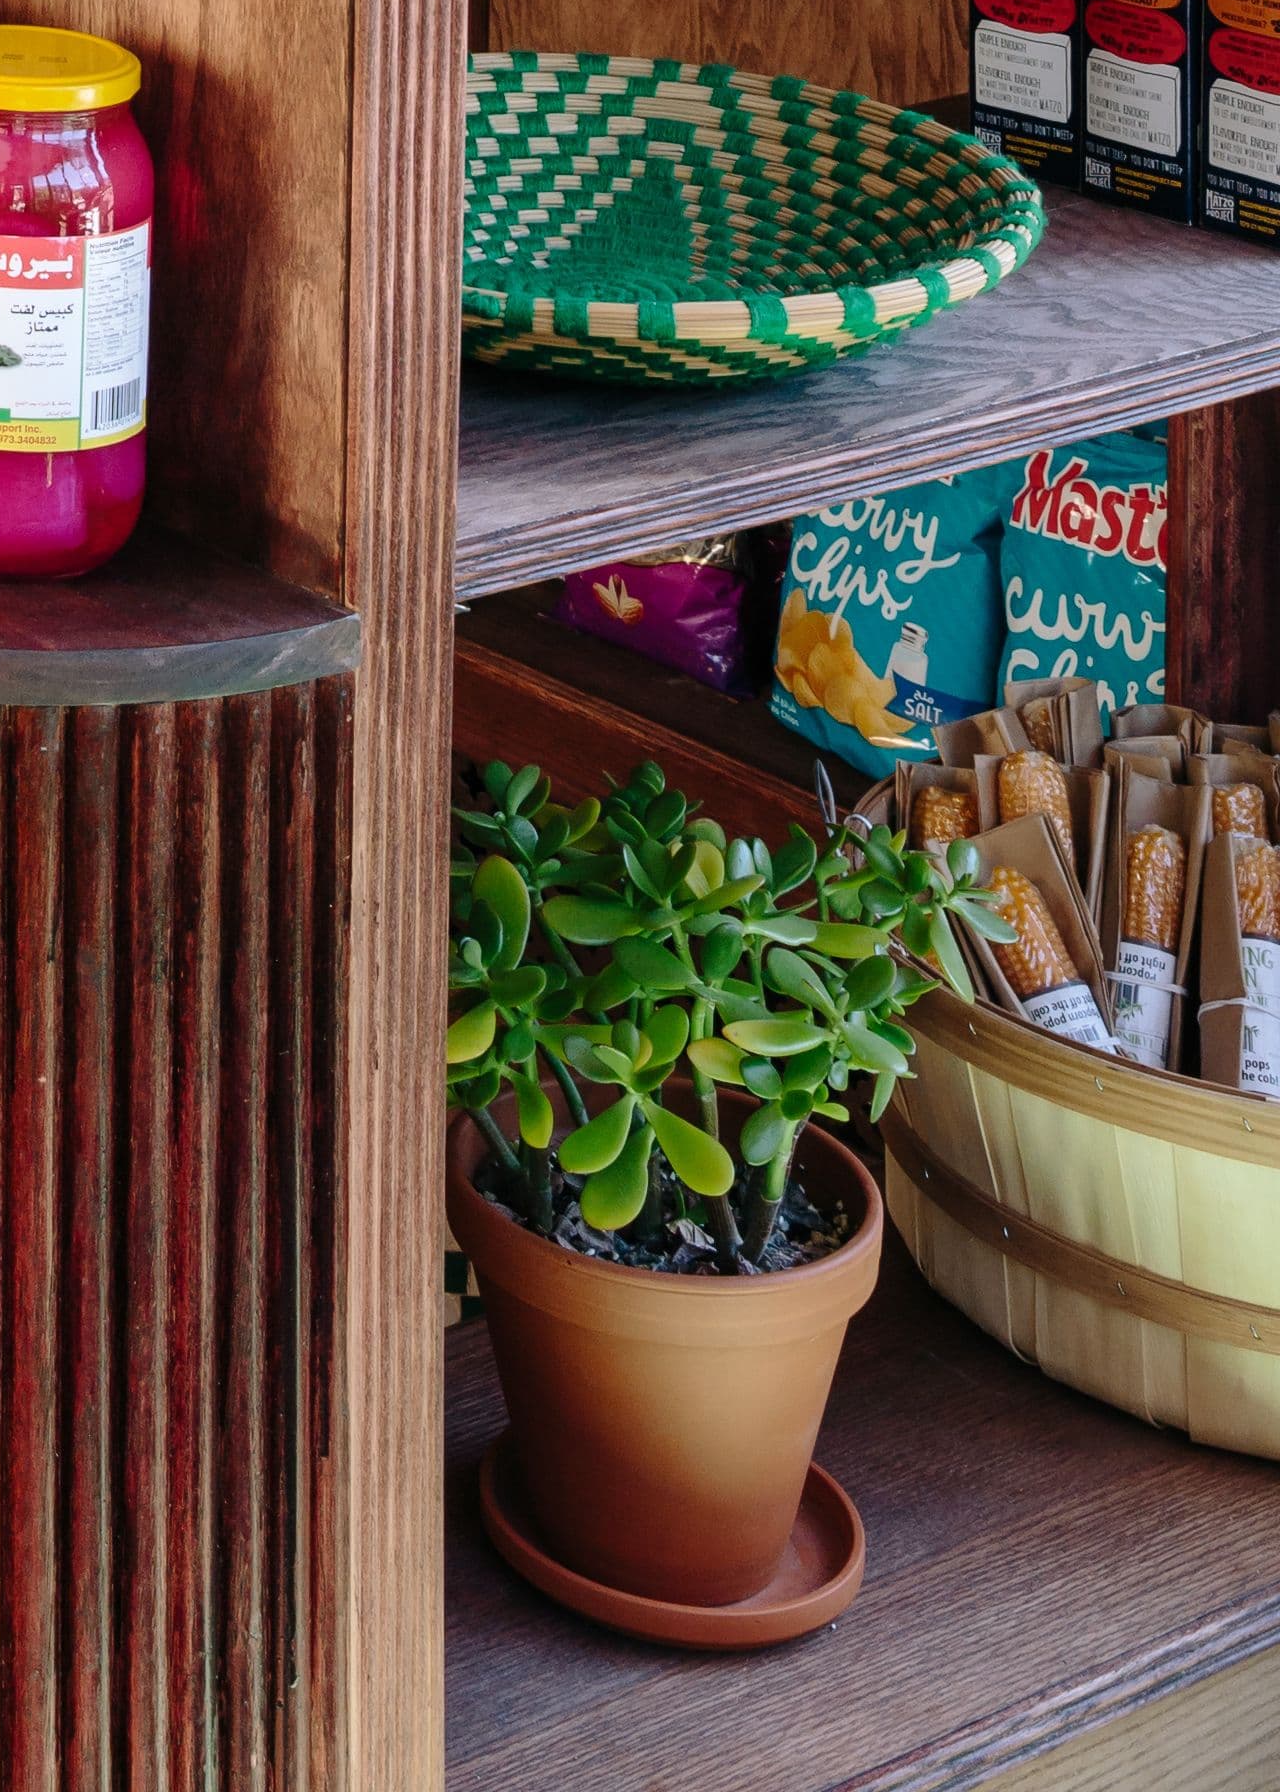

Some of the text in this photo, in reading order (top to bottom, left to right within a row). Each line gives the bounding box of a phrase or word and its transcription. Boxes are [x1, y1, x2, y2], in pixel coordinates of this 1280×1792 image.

[1206, 189, 1235, 209] MATZO
[790, 530, 914, 640] Chips
[903, 700, 943, 723] SALT
[1244, 1057, 1271, 1072] pops
[1257, 1072, 1280, 1087] cob!
